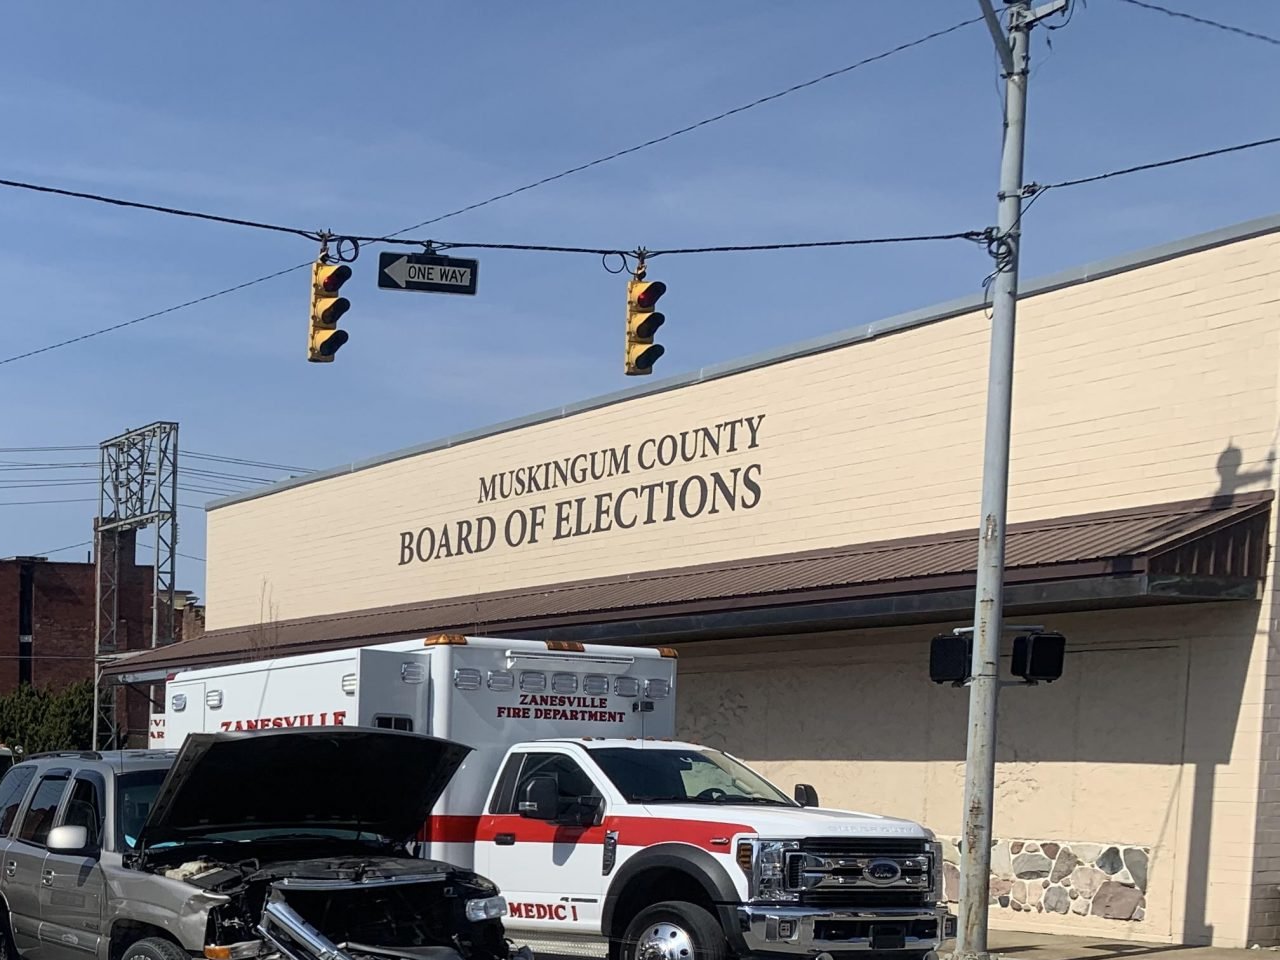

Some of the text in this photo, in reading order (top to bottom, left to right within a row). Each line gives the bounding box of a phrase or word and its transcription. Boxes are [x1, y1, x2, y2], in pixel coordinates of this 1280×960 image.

[408, 265, 467, 283] ONE WAY
[477, 414, 766, 503] MUSKINGUM COUNTY
[398, 464, 762, 566] BOARD OF ELECTIONS
[519, 694, 608, 709] ZANESVILLE
[496, 706, 625, 722] FIRE DEPARTMENT
[508, 902, 567, 920] MEDIC
